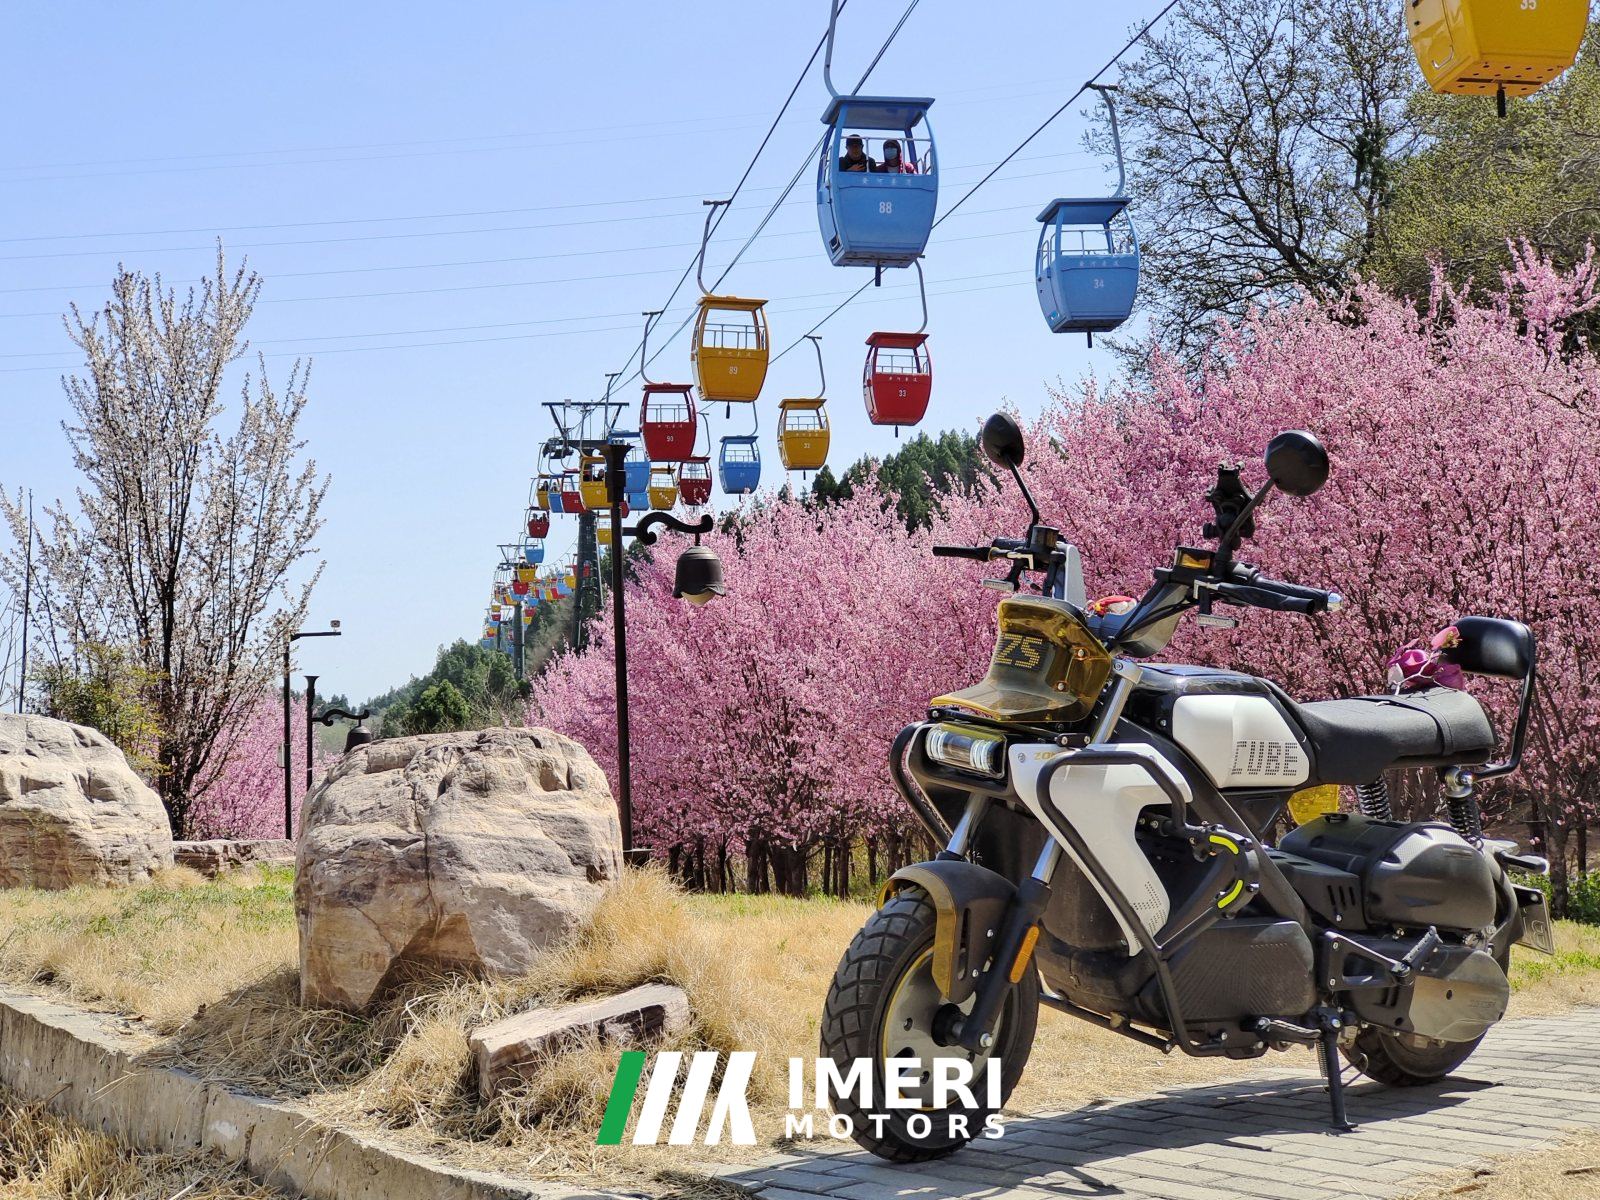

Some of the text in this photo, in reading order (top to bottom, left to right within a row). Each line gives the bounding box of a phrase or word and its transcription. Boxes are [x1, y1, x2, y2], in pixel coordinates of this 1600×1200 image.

[879, 201, 892, 214] 88
[1093, 279, 1104, 289] 34
[728, 366, 738, 375] 89
[898, 389, 907, 397] 33
[1231, 741, 1298, 776] CUBE
